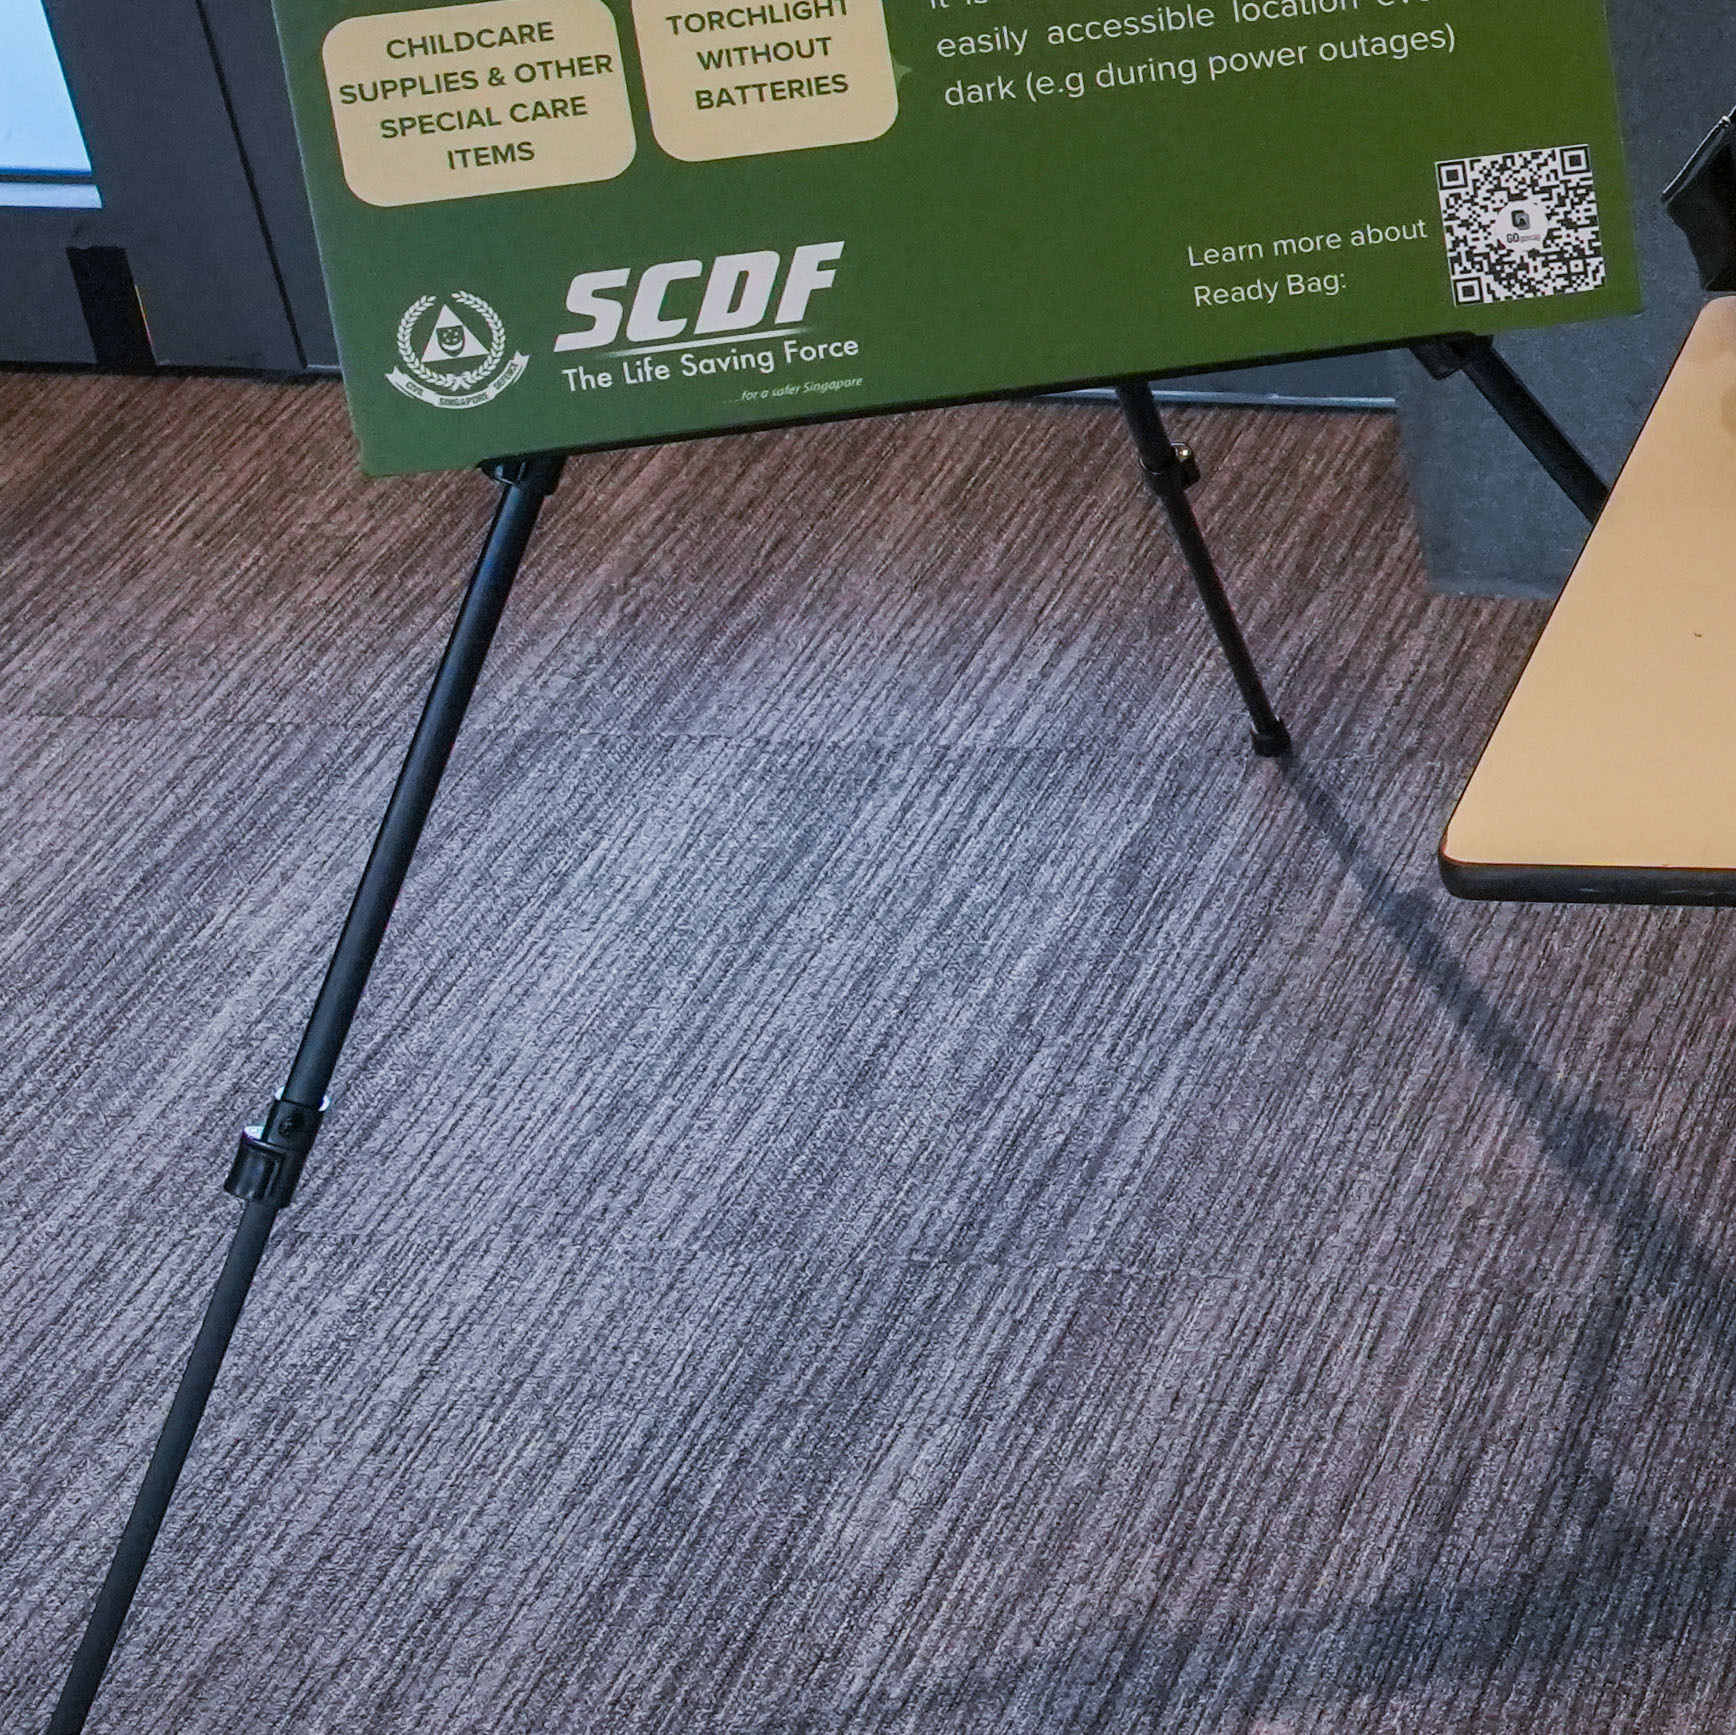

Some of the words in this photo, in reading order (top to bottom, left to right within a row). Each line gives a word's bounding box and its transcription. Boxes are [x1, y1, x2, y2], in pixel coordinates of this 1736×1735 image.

[386, 21, 555, 60] CHILDCARE
[936, 25, 1028, 58] easily
[1047, 3, 1215, 45] accessible
[696, 36, 832, 71] WITHOUT
[944, 75, 1017, 106] dark
[1026, 71, 1085, 103] (e.g
[1095, 57, 1197, 88] during
[1208, 45, 1308, 81] power
[1318, 22, 1455, 62] outages)
[339, 69, 479, 105] SUPPLIES
[487, 66, 507, 87] &
[514, 54, 614, 84] OTHER
[695, 73, 849, 110] BATTERIES
[380, 106, 502, 139] SPECIAL
[509, 95, 588, 123] CARE
[447, 141, 535, 170] ITEMS
[1187, 242, 1264, 267] Learn
[1272, 232, 1342, 257] more
[1350, 218, 1428, 247] about
[553, 240, 845, 353] SCDF
[1193, 278, 1279, 307] Ready
[1286, 273, 1347, 296] Bag:
[561, 365, 613, 392] The
[622, 356, 671, 385] Life
[680, 348, 775, 377] Saving
[783, 339, 859, 364] Force
[803, 377, 864, 394] Singapore
